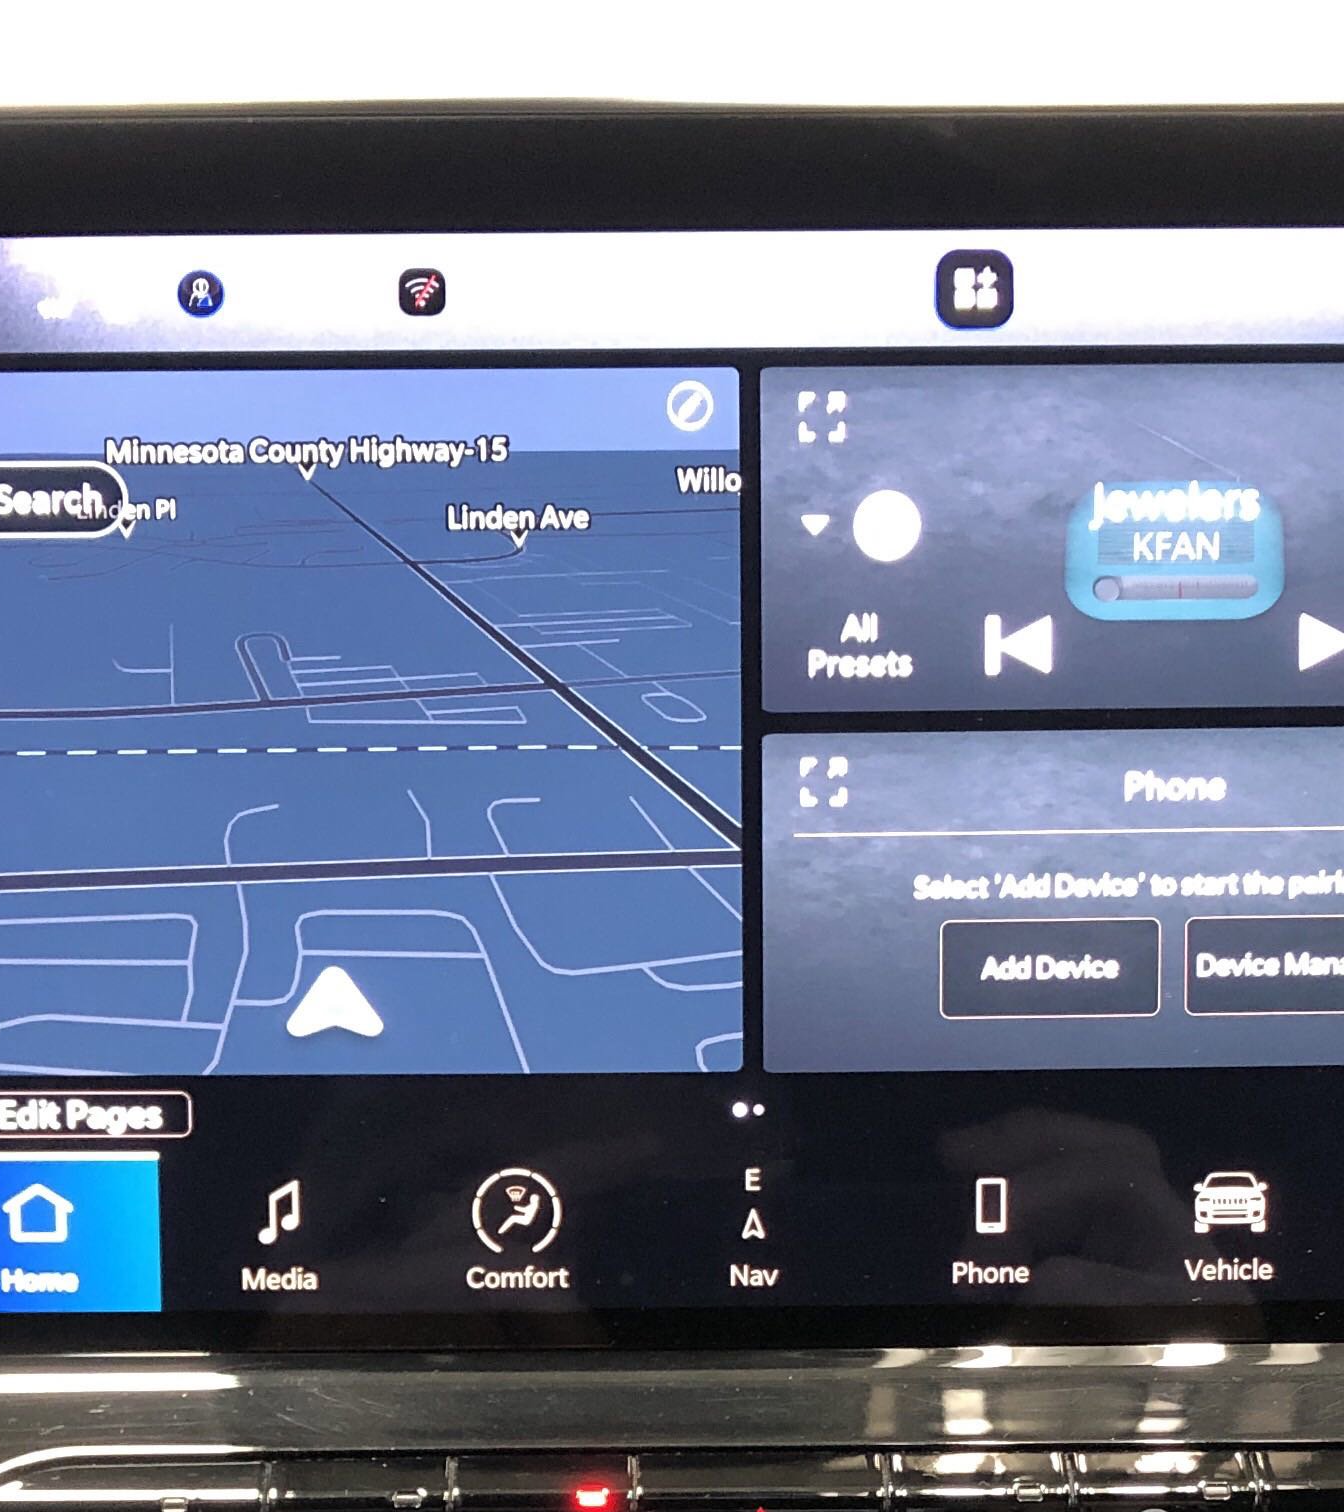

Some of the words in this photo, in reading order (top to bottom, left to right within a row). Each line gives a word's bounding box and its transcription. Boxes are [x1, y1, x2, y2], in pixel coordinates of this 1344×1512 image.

[106, 438, 245, 464] Minnesota
[249, 438, 345, 469] County
[348, 436, 509, 467] Highway-15
[447, 505, 536, 530] Linden
[540, 505, 589, 529] Ave
[1133, 531, 1220, 561] KFAN
[840, 613, 878, 643] All
[808, 648, 912, 678] Presets
[1124, 770, 1226, 803] Phone
[914, 875, 989, 900] Select
[1151, 876, 1177, 897] to
[1181, 874, 1239, 896] start
[1243, 871, 1285, 895] the
[981, 956, 1032, 980] Add
[1036, 956, 1119, 979] Device
[1196, 953, 1279, 978] Device
[66, 1101, 163, 1135] Pages
[744, 1169, 761, 1191] E
[0, 1268, 78, 1291] Home
[241, 1266, 318, 1290] Media
[466, 1265, 569, 1289] Comfort
[730, 1263, 778, 1286] Nav
[952, 1261, 1030, 1284] Phone
[1185, 1258, 1273, 1281] Vehicle
